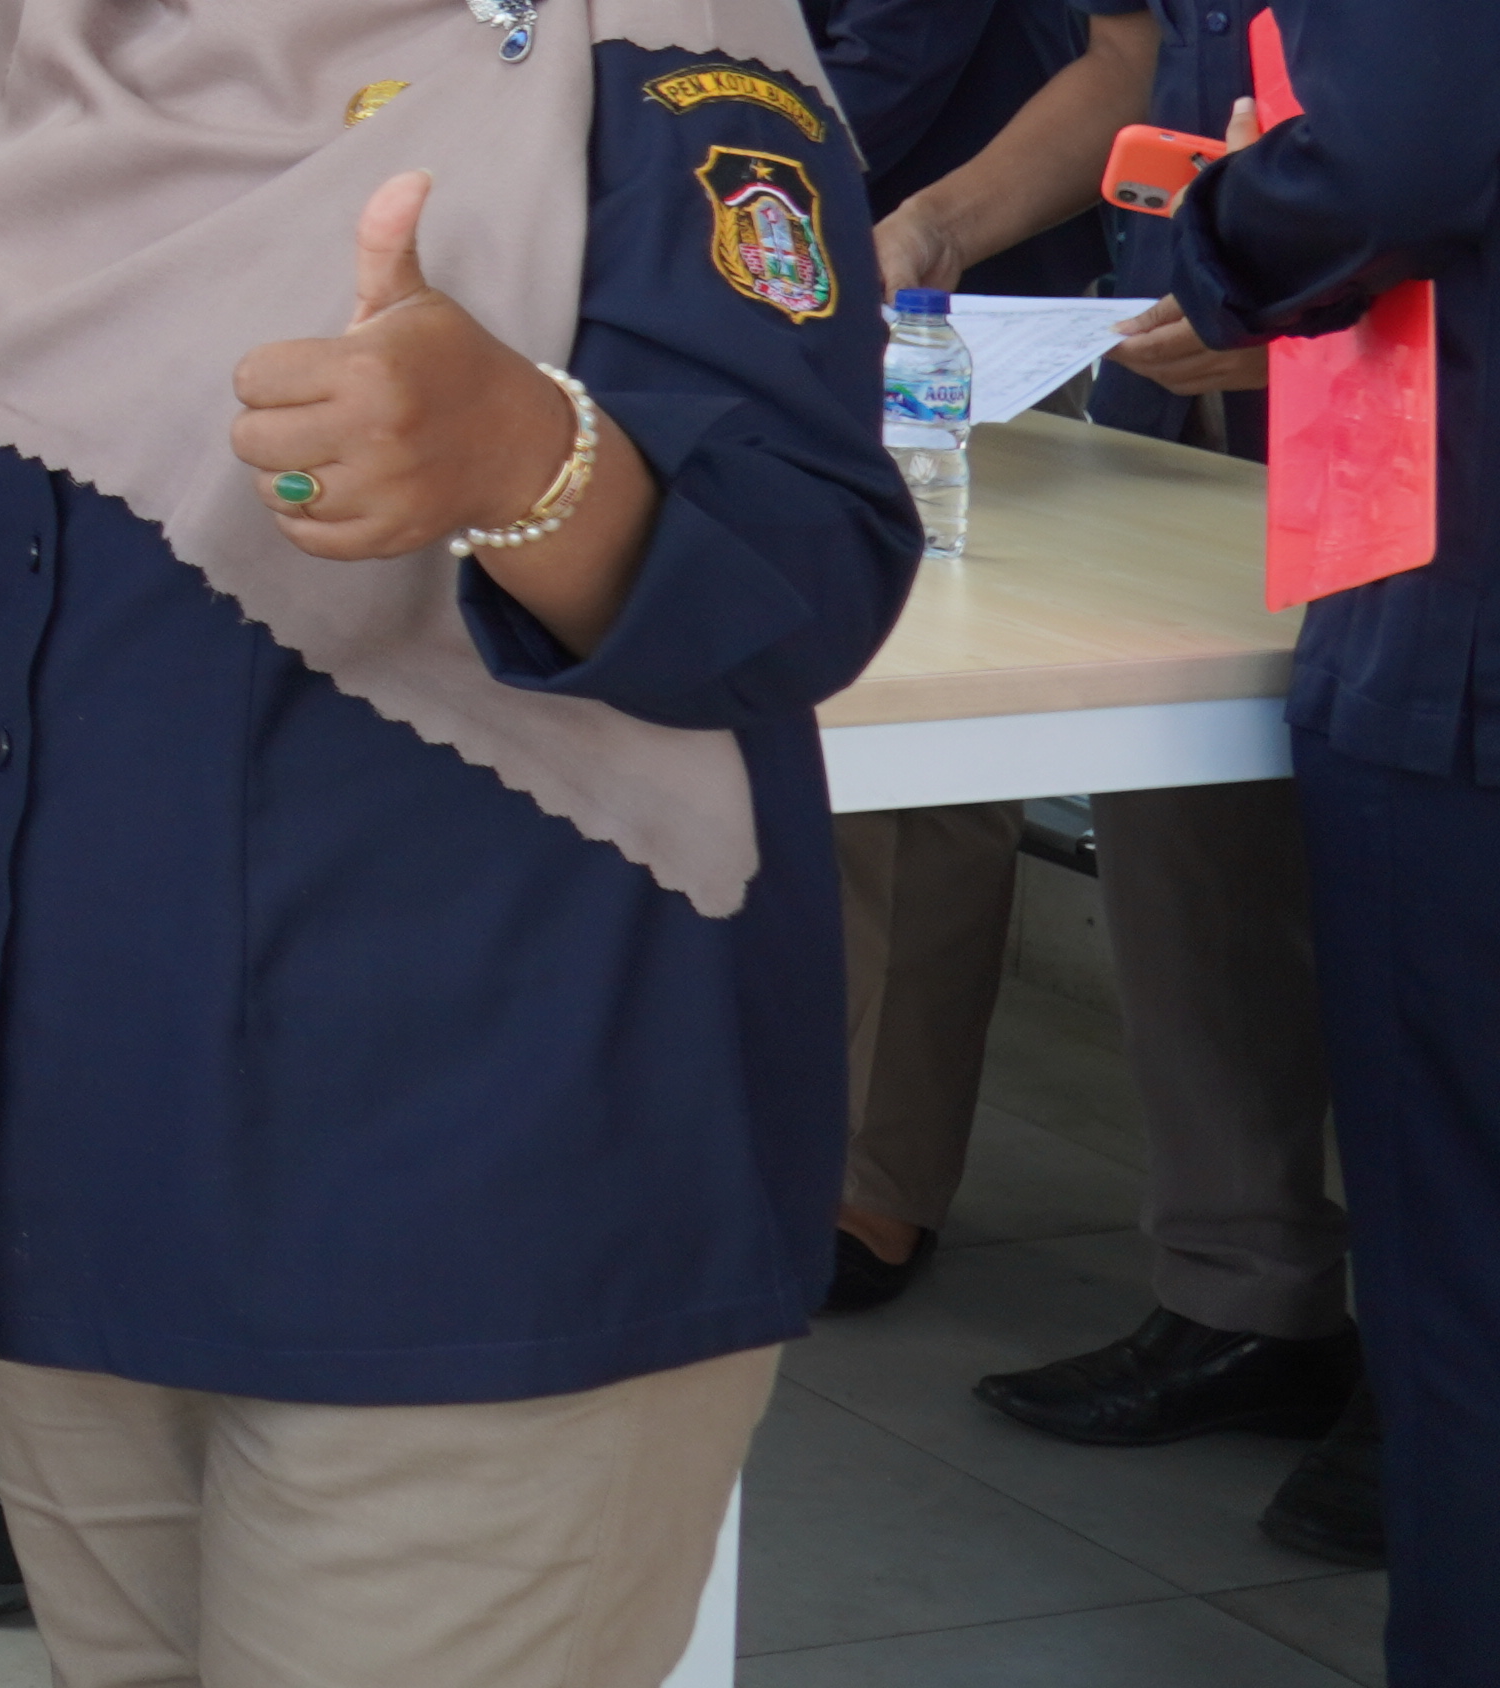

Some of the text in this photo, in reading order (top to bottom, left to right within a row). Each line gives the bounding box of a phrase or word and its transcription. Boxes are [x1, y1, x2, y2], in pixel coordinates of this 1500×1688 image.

[665, 75, 705, 102] PEM
[712, 71, 760, 94] KOTA
[925, 384, 965, 402] AQUA
